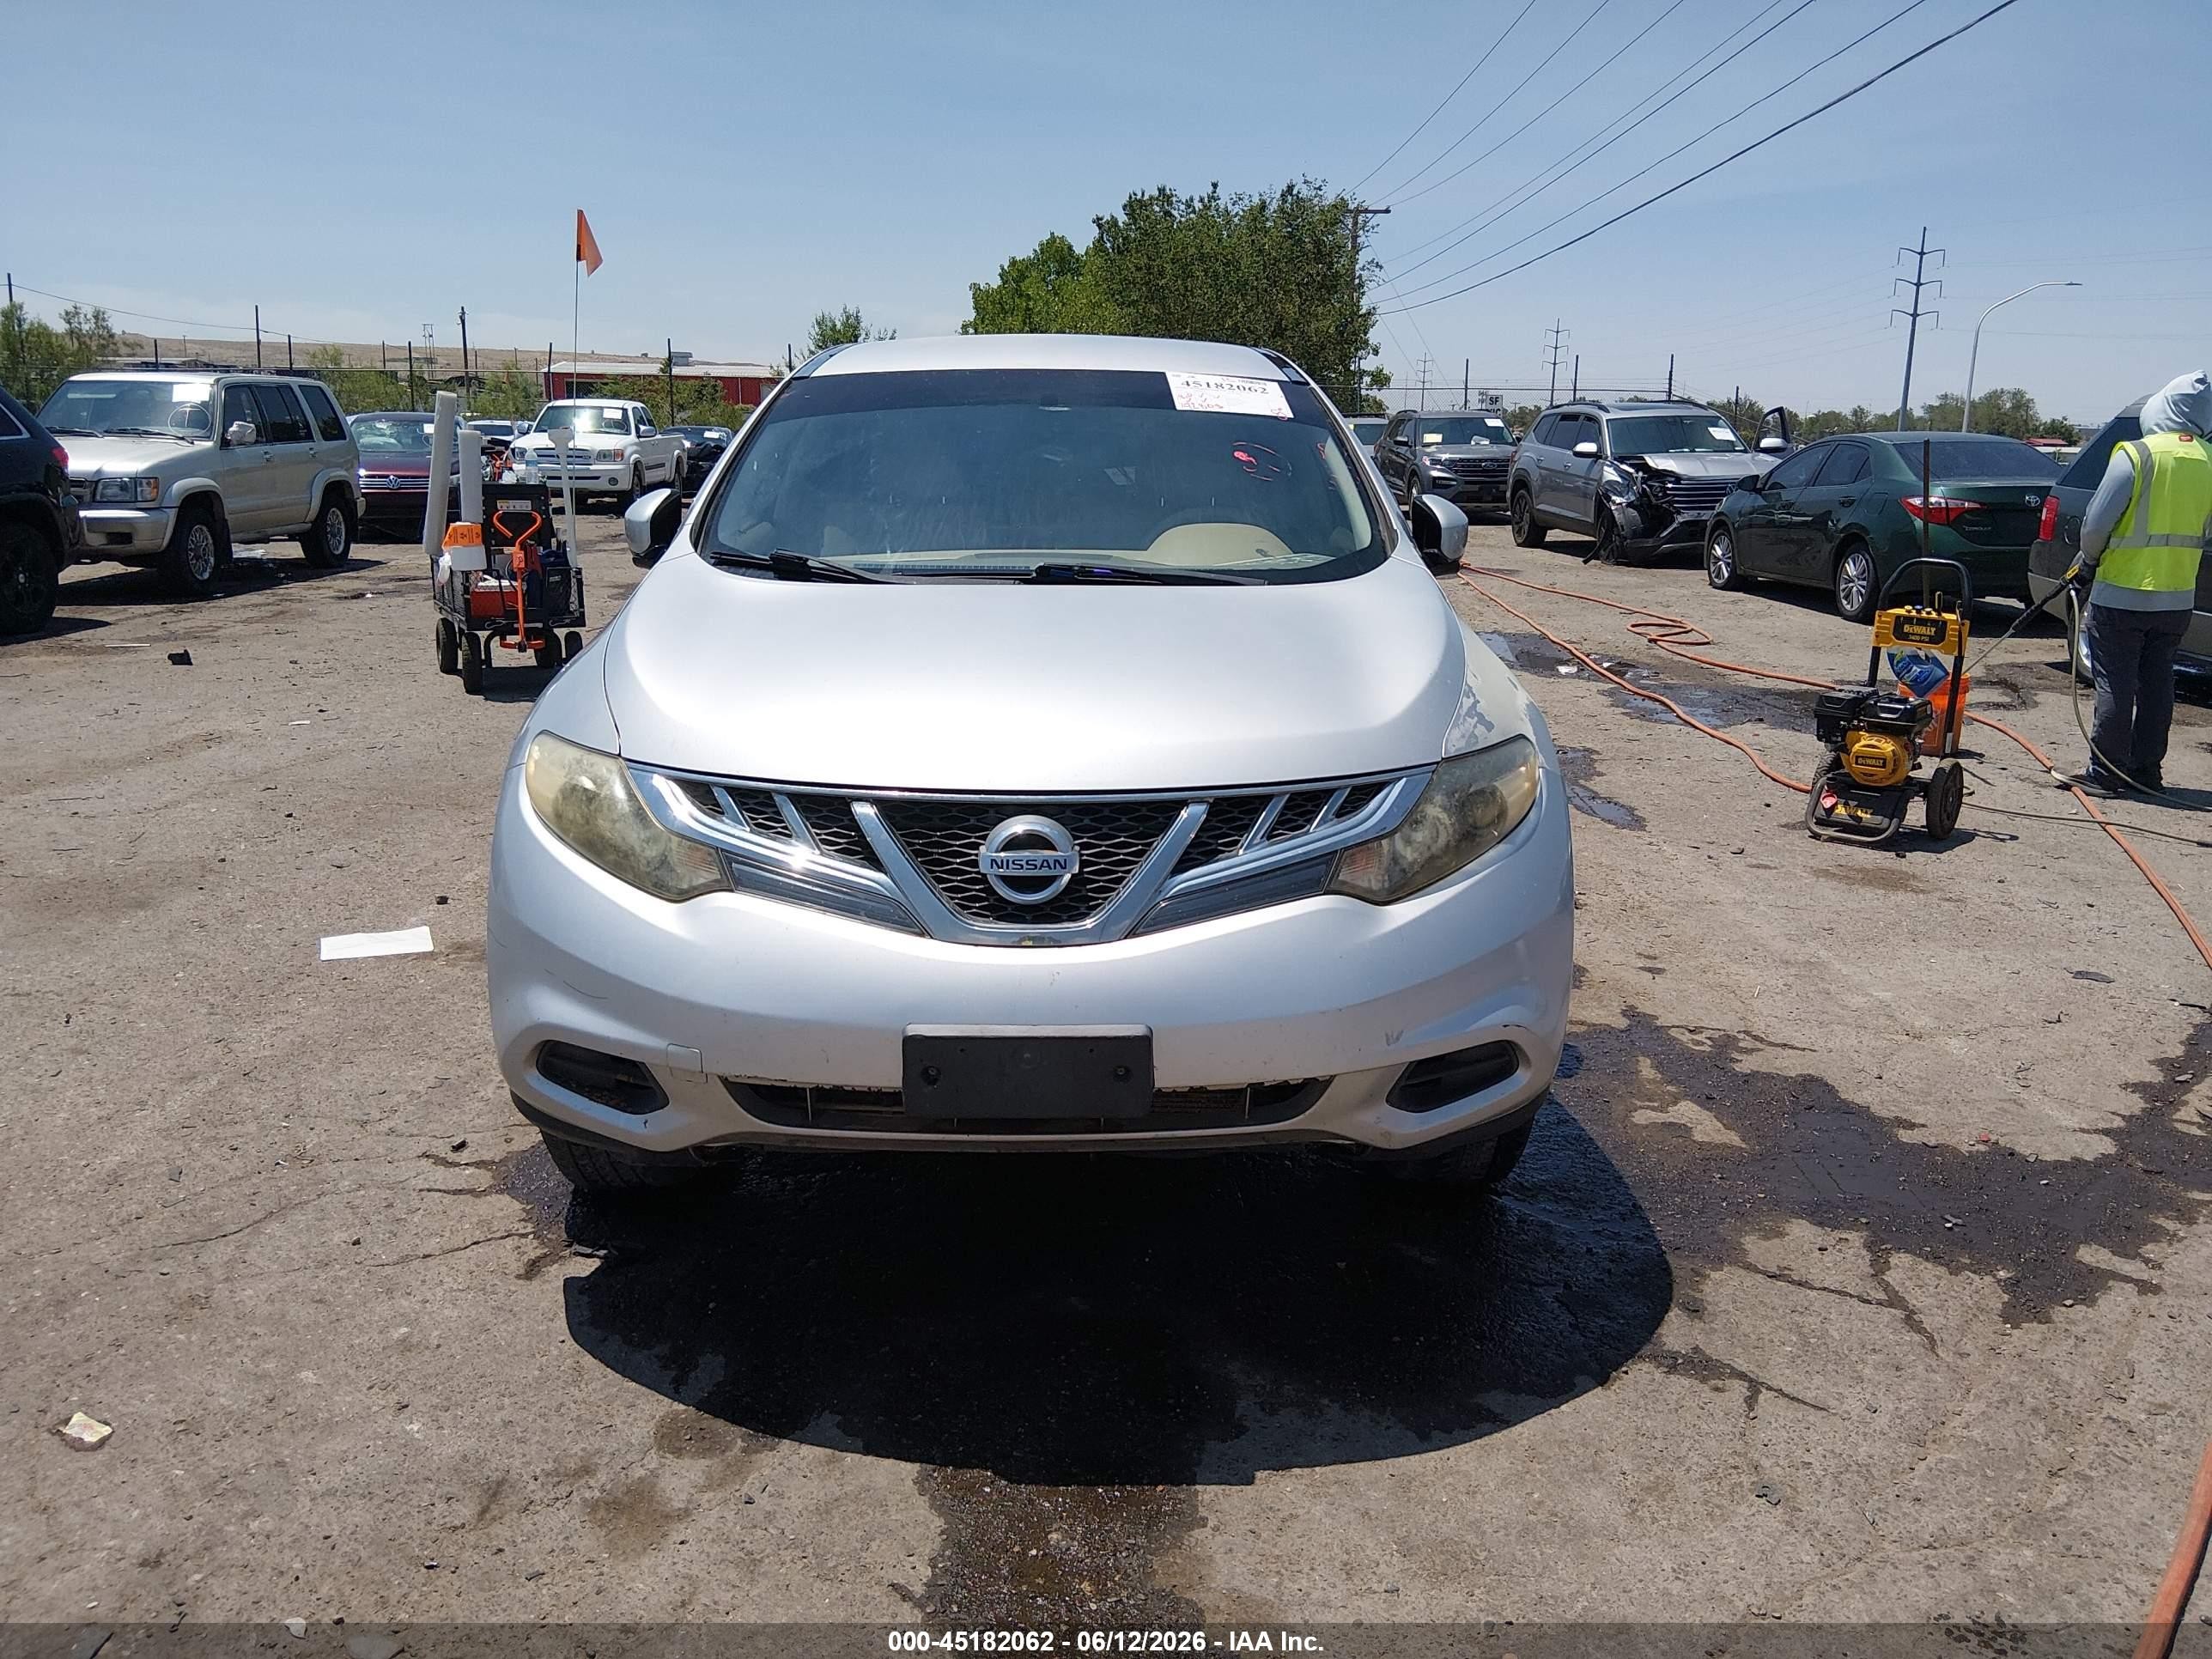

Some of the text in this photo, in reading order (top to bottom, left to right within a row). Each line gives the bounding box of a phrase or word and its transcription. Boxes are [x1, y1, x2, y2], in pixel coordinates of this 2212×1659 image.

[1181, 380, 1270, 394] 45182062
[1488, 396, 1500, 406] SF
[989, 858, 1067, 871] NISSAN
